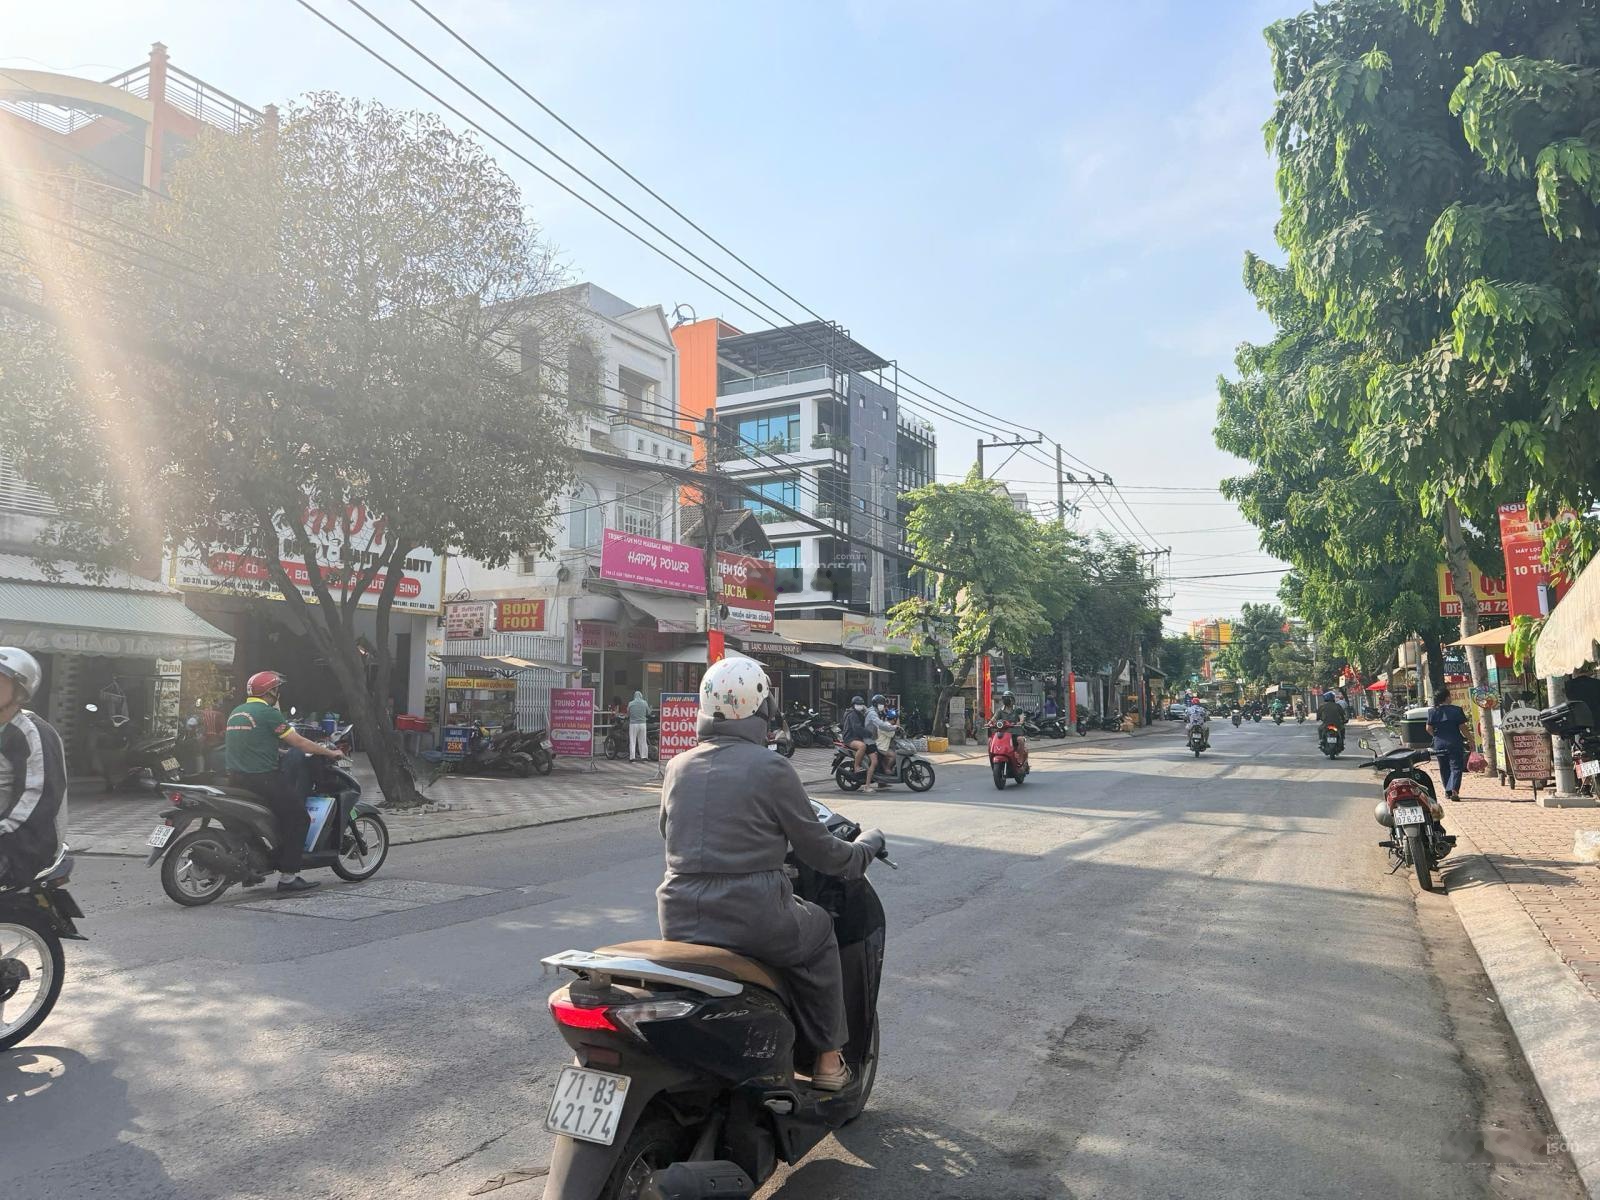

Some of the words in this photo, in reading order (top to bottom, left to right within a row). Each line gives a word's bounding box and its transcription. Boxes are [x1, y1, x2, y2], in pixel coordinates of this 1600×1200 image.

[627, 551, 658, 571] HAPPY
[659, 557, 690, 574] POWER
[1513, 565, 1529, 576] 10
[399, 582, 420, 595] SINH
[502, 602, 539, 615] BODY
[503, 616, 538, 629] FOOT
[554, 699, 576, 707] TRUNG
[576, 697, 591, 707] TÂM
[662, 704, 698, 718] BÁNH
[662, 718, 697, 732] CUỐN
[1504, 722, 1525, 731] PHA
[661, 733, 698, 747] NÓNG
[564, 1071, 617, 1106] 71-B3
[550, 1100, 612, 1139] 421.74
